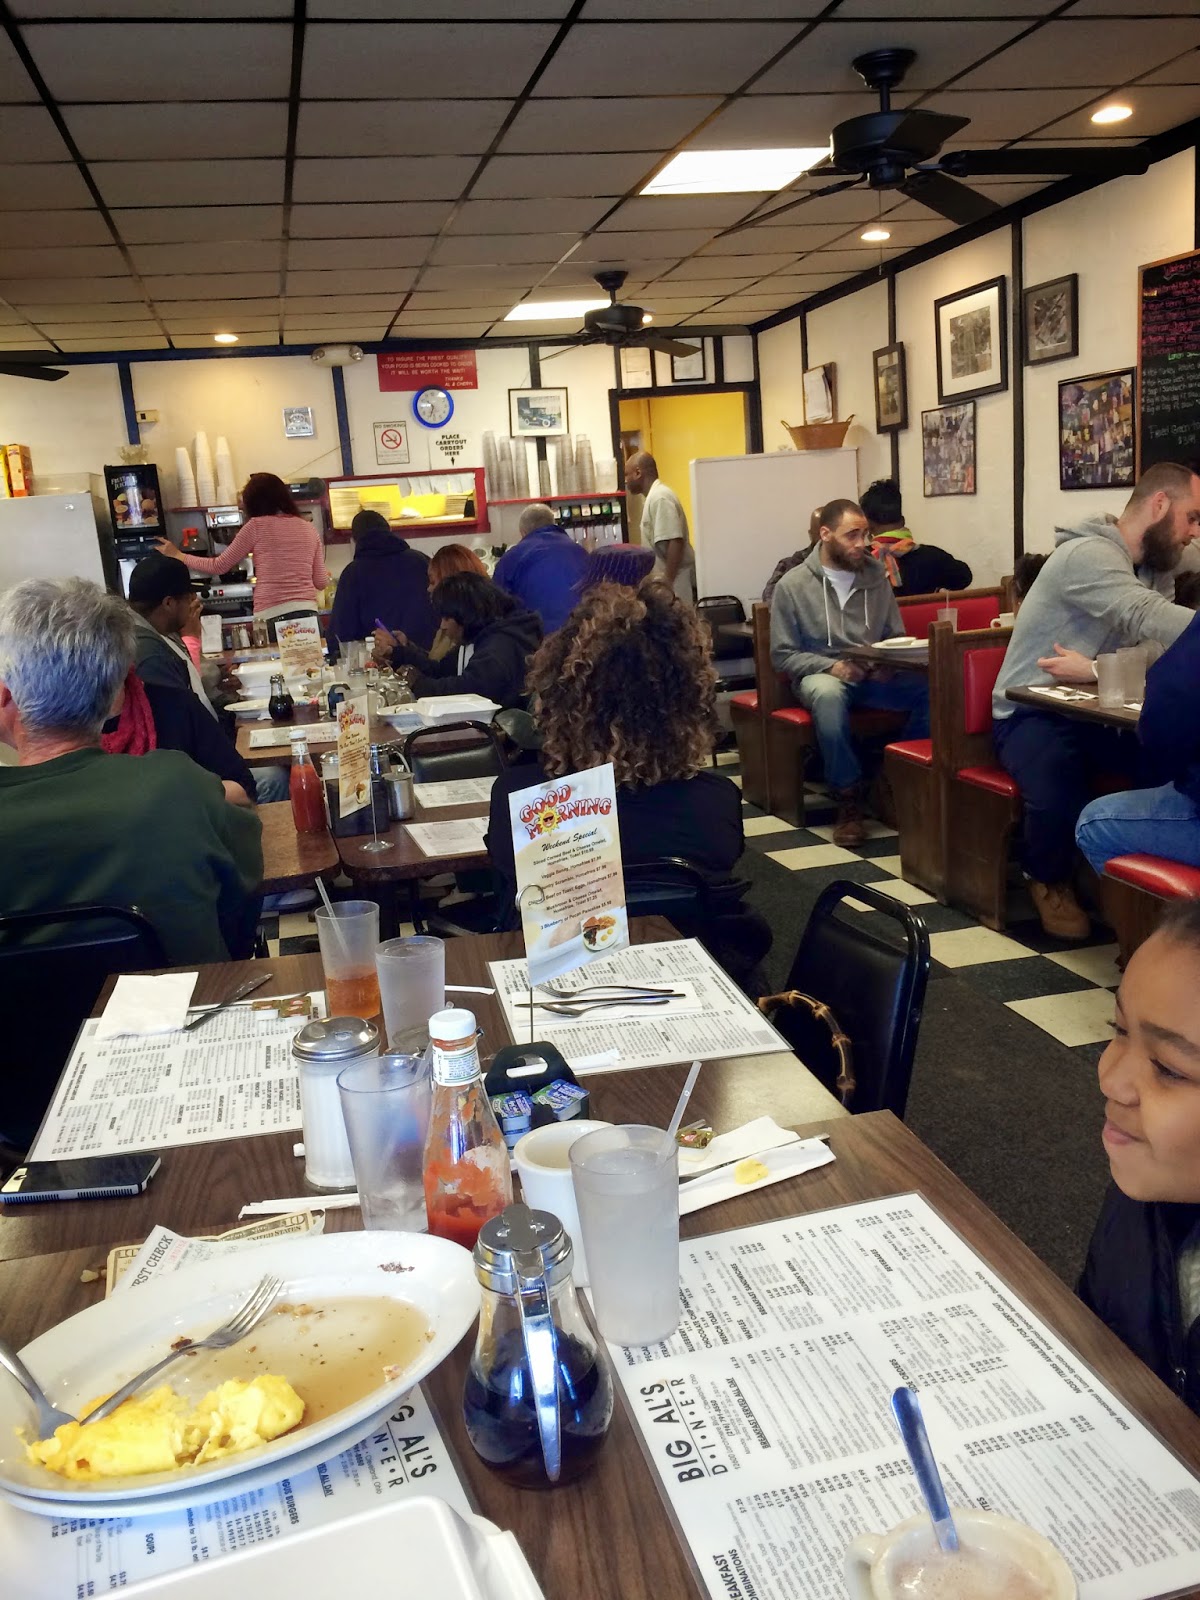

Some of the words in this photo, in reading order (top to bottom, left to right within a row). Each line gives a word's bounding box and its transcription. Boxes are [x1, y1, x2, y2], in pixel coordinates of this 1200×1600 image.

[519, 784, 572, 824] GOOD
[525, 798, 612, 840] MRNING
[541, 835, 570, 852] Weekend
[572, 826, 597, 843] Special
[576, 842, 590, 851] Cheese
[543, 917, 563, 928] Blueberry
[274, 1226, 301, 1236] STATES
[146, 1234, 173, 1268] CHECK
[869, 1248, 894, 1272] BEVERAGES
[729, 1262, 752, 1291] SANDWICHES
[783, 1259, 797, 1272] MENU
[685, 1308, 697, 1320] CHIP
[747, 1290, 768, 1315] BREAKFAST
[994, 1293, 1018, 1312] Available
[705, 1309, 719, 1325] TOAST
[735, 1318, 754, 1339] WAFFLES
[1012, 1311, 1035, 1330] Specials
[677, 1327, 696, 1352] BLUEBERRY
[692, 1319, 713, 1348] CHOCOLATE
[713, 1324, 730, 1345] FRENCH
[1015, 1327, 1031, 1338] FOR
[1028, 1329, 1054, 1350] Breakfast
[1025, 1337, 1054, 1363] AVAILABLE
[887, 1357, 910, 1380] ORDERS
[1048, 1362, 1068, 1378] ITEMS
[1052, 1353, 1078, 1374] Specials
[724, 1376, 737, 1388] DAY
[730, 1387, 743, 1397] ALL
[904, 1380, 920, 1394] SIDE
[1062, 1377, 1083, 1393] MOST
[1071, 1373, 1091, 1388] Lunch
[640, 1383, 679, 1424] AL'S
[736, 1397, 754, 1419] SERVED
[1089, 1392, 1118, 1417] Breakfast
[747, 1417, 771, 1449] BREAKFAST
[1112, 1415, 1132, 1430] Daily
[399, 1433, 437, 1478] AL'S
[666, 1440, 705, 1483] BIG
[321, 1483, 335, 1497] DAY
[281, 1494, 302, 1525] BURGERS
[240, 1514, 258, 1544] $6.75/$7.7
[249, 1511, 267, 1541] $6.25/$7.2
[258, 1509, 277, 1538] $5.95/$6.9
[141, 1532, 158, 1555] SOUPS
[711, 1552, 742, 1600] EAKFAST
[727, 1547, 759, 1600] OMBINATIONS
